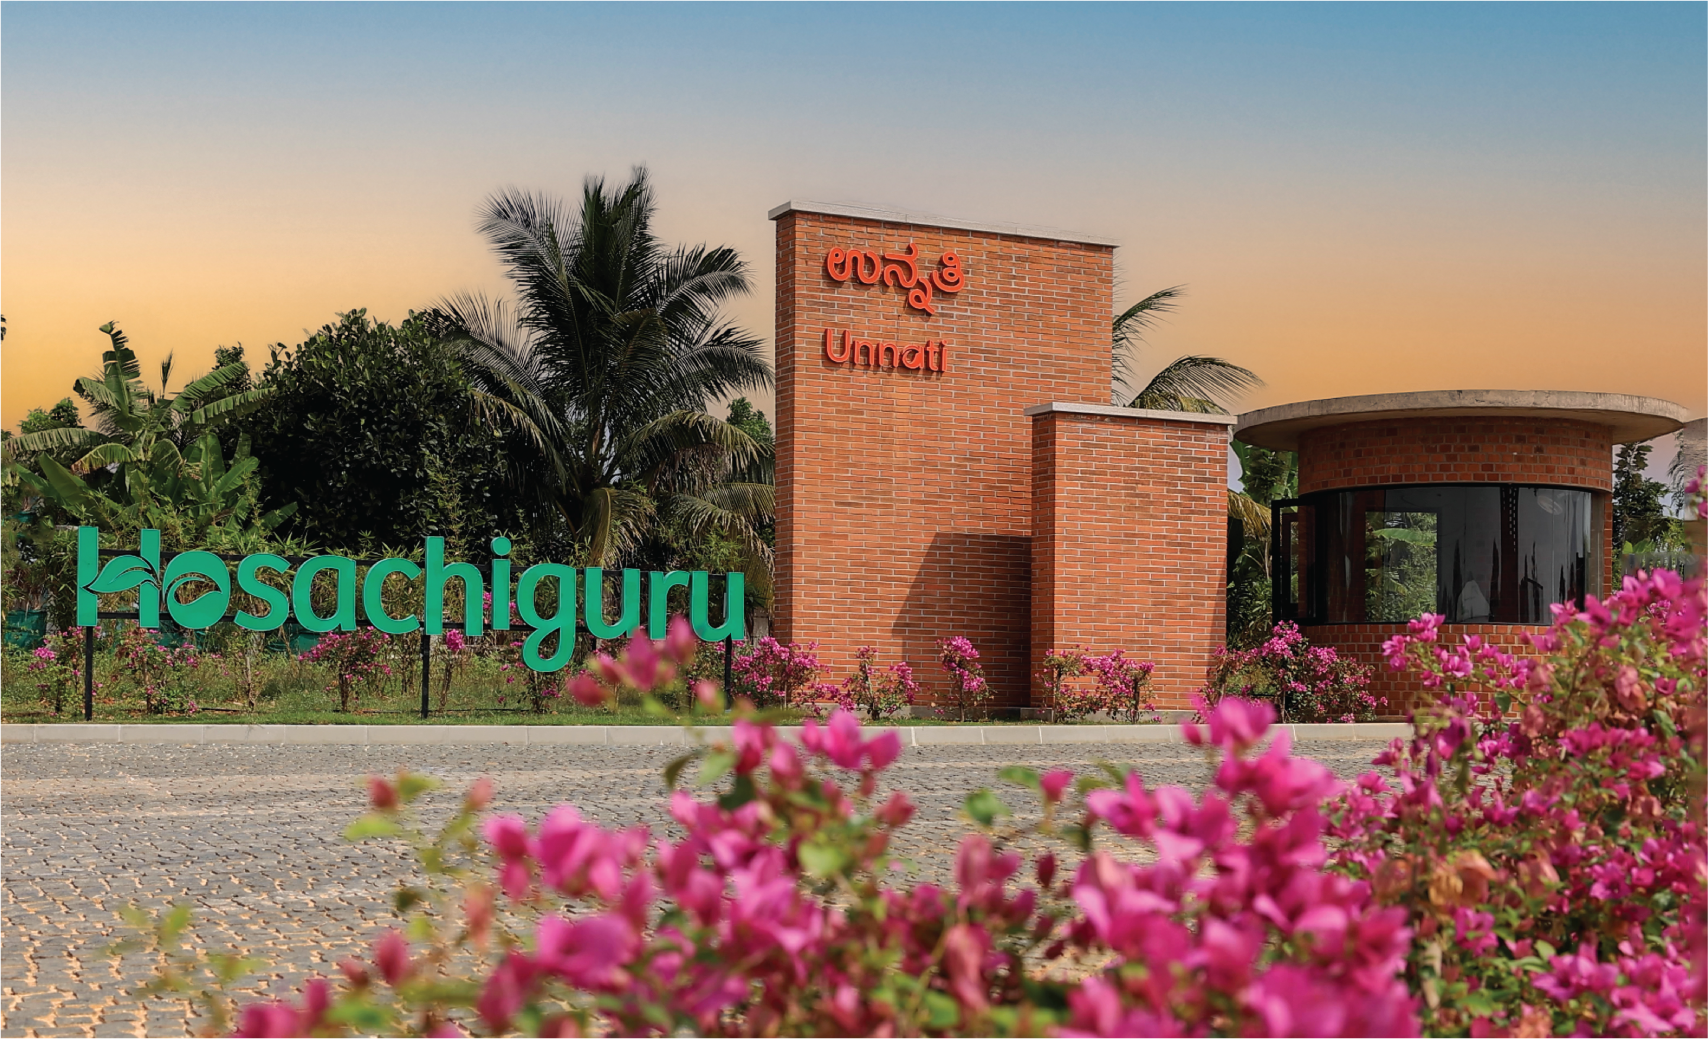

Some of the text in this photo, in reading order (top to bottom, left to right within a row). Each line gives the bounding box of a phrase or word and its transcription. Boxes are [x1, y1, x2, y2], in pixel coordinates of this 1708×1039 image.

[826, 242, 965, 315] ಉನ್ನತಿ
[824, 328, 948, 372] Unnati
[77, 526, 745, 673] Hosachiguru
